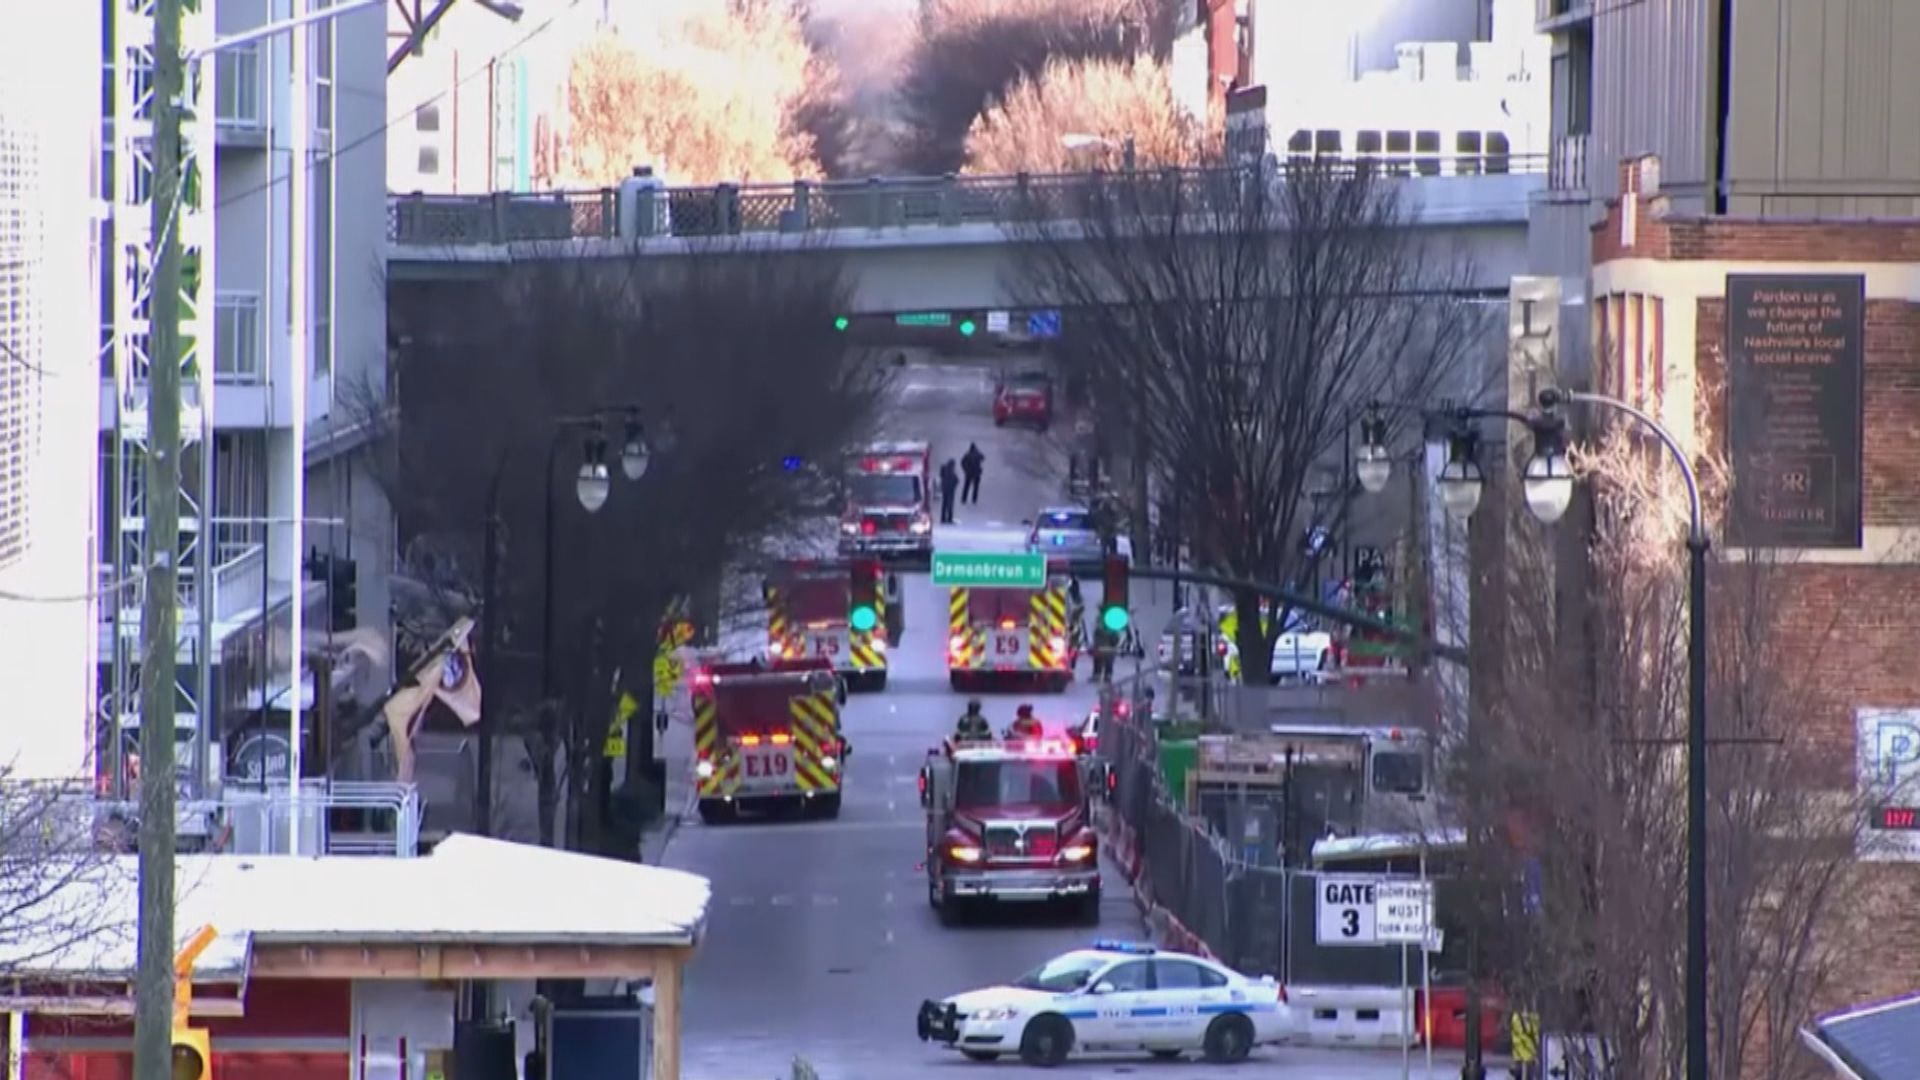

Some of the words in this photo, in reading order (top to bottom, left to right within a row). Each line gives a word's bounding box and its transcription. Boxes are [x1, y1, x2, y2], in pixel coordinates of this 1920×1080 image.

[1753, 290, 1800, 303] Pardon
[1803, 293, 1818, 303] us
[1822, 293, 1836, 303] as
[1747, 308, 1766, 318] we
[1769, 306, 1817, 320] change
[1820, 306, 1842, 318] the
[1766, 320, 1805, 333] future
[1808, 320, 1823, 333] of
[1744, 336, 1811, 349] Nashville's
[1814, 336, 1845, 349] local
[1754, 352, 1791, 364] social
[935, 561, 1024, 578] Demonbreun
[815, 636, 839, 656] E5
[996, 635, 1019, 655] E9
[745, 752, 788, 777] E19
[1325, 883, 1374, 905] GATE
[1388, 904, 1420, 918] MUST
[1341, 908, 1360, 937] 3
[1378, 923, 1401, 934] TURN
